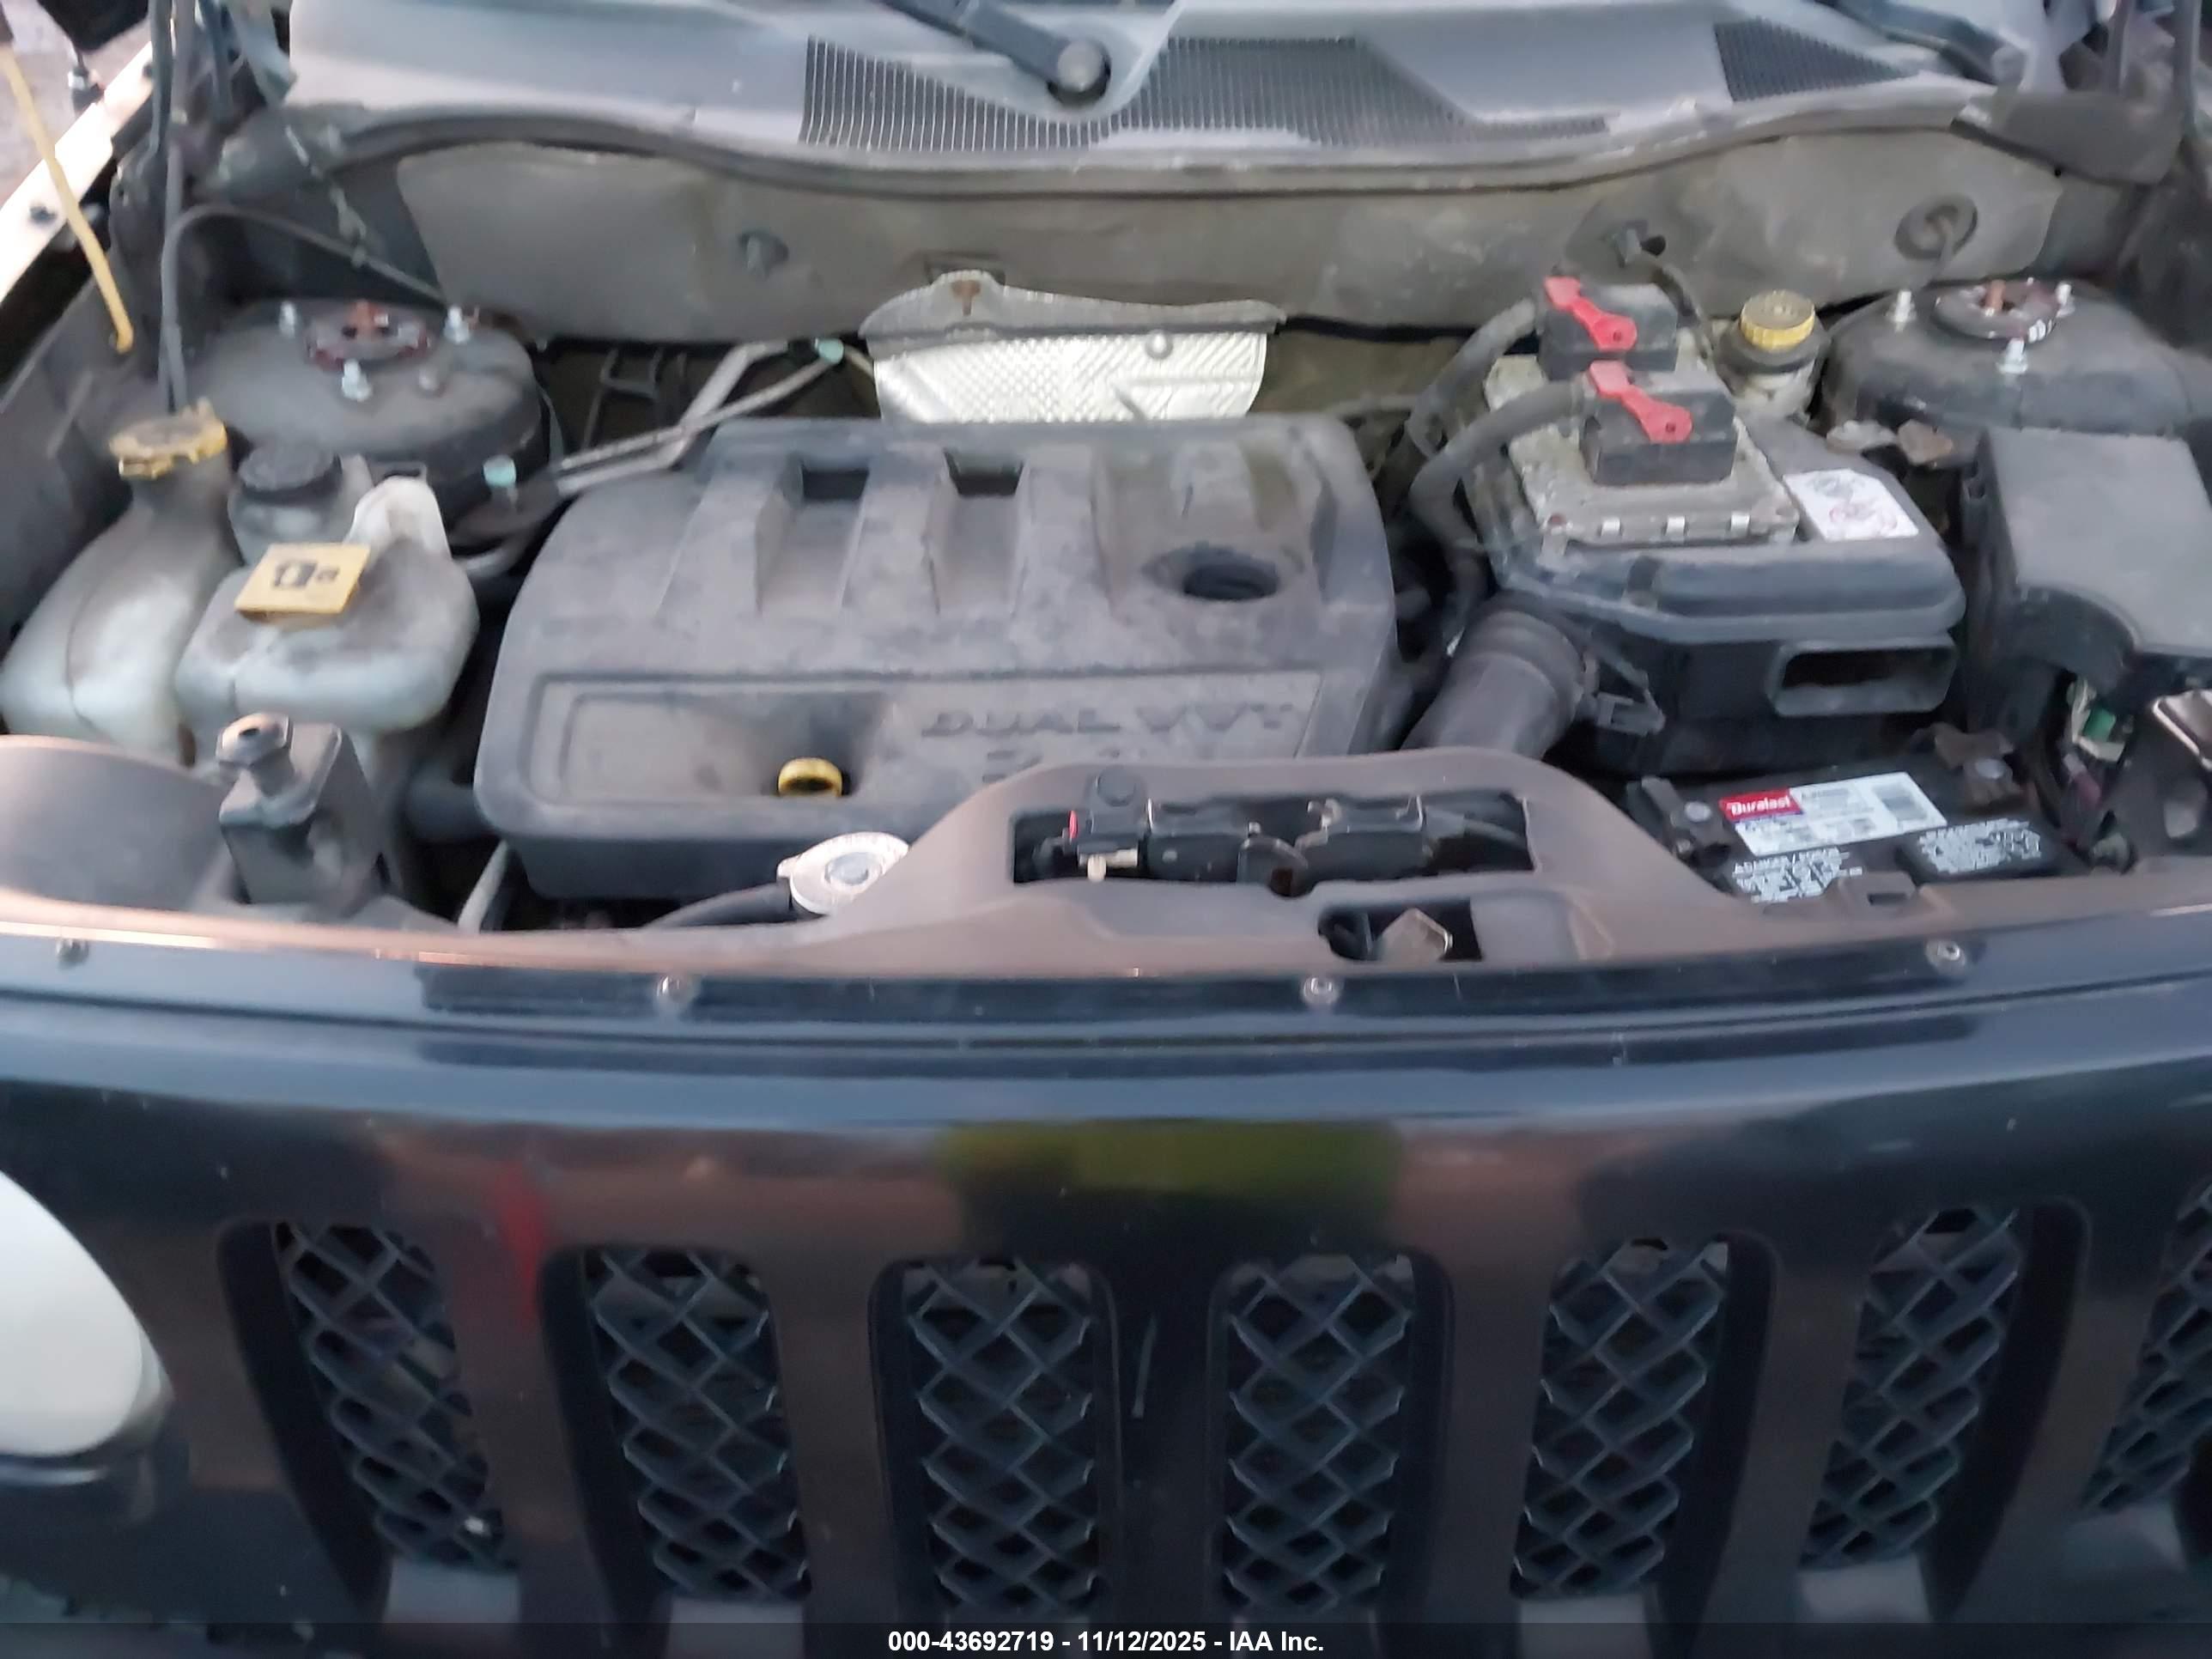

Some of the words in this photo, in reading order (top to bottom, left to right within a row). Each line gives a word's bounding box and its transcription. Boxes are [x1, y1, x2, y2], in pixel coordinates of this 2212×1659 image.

[920, 705, 1121, 738] DUAL
[1134, 700, 1295, 736] VVT
[1726, 794, 1791, 817] Duralast
